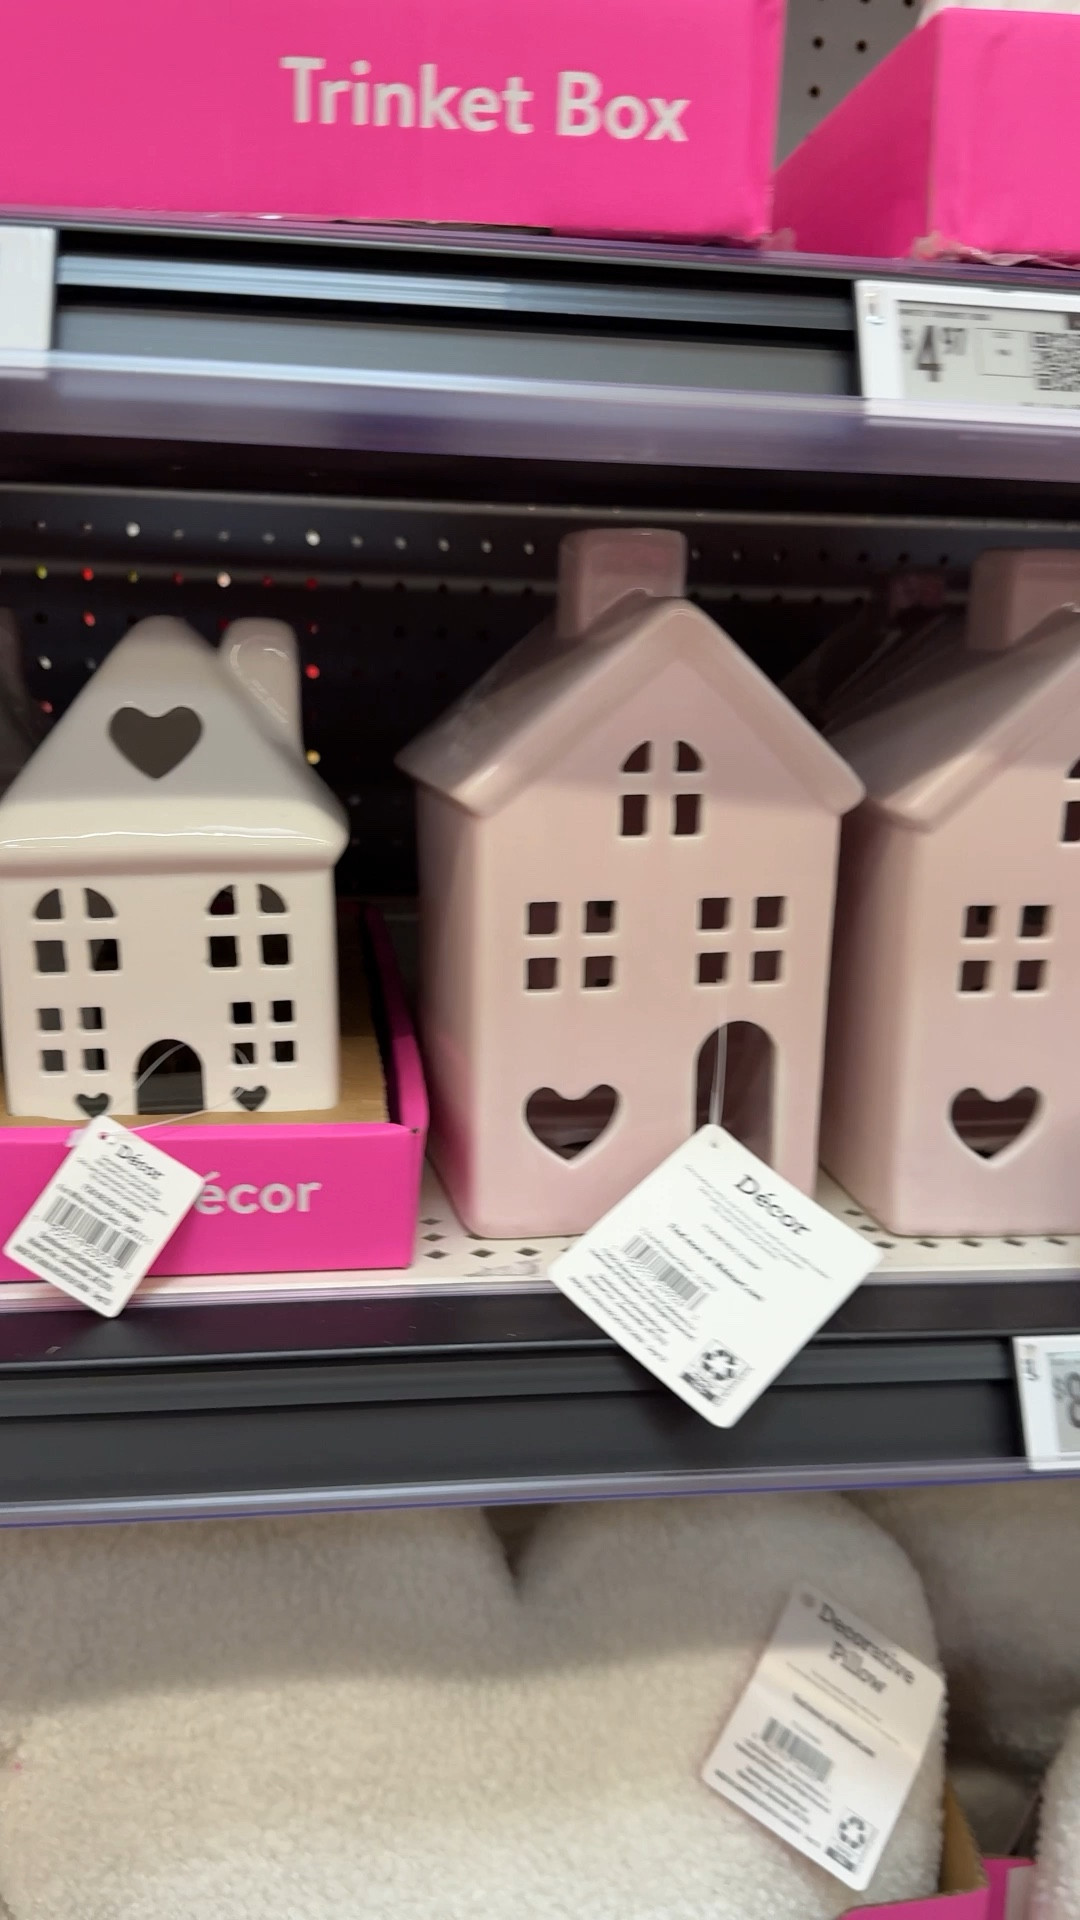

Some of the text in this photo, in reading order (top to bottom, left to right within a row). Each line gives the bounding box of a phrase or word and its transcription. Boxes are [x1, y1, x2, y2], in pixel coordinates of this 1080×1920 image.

[279, 56, 691, 142] Trinket Box
[195, 1171, 322, 1215] écor
[734, 1174, 811, 1235] Décor
[818, 1602, 914, 1684] Decorative
[829, 1641, 887, 1693] Pillow
